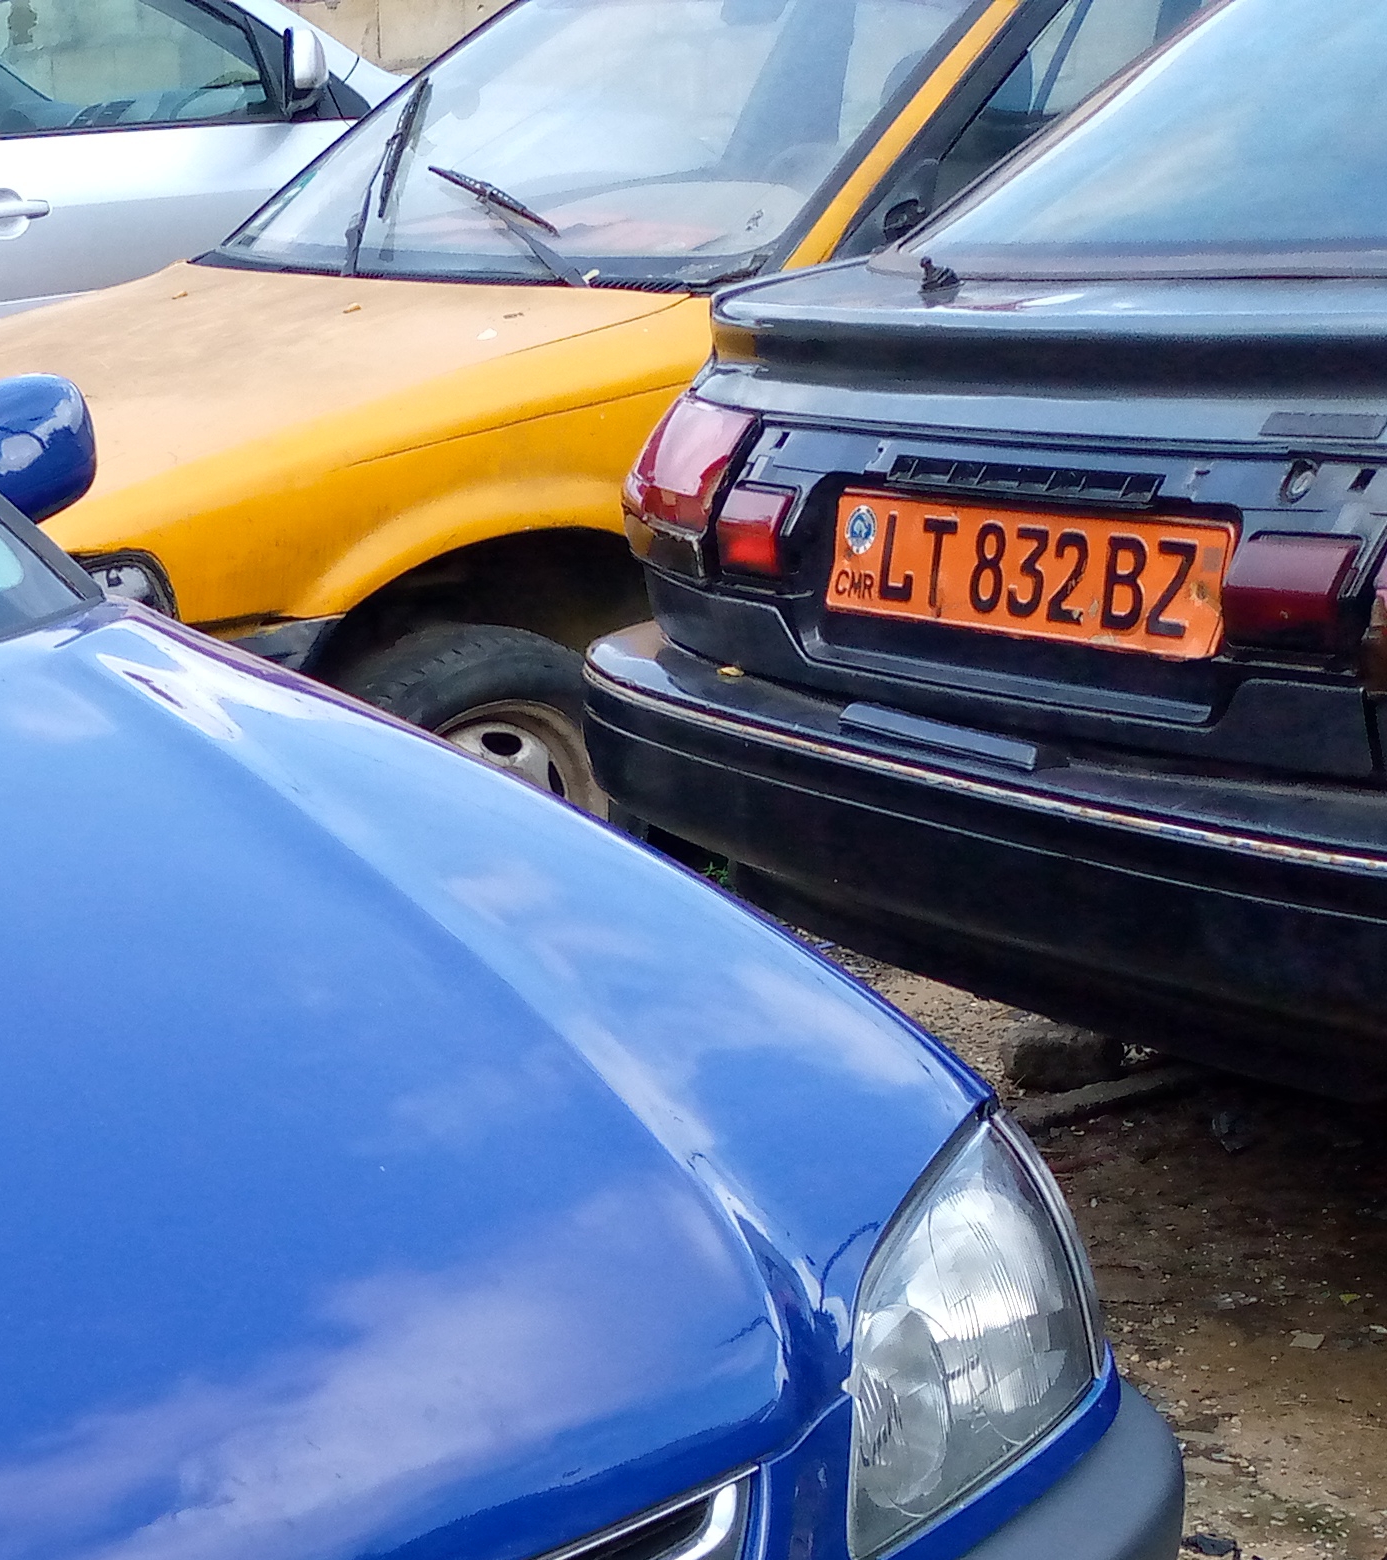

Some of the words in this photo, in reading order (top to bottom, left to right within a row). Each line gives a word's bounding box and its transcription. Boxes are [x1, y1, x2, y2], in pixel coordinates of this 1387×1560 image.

[835, 569, 874, 600] CMR
[878, 513, 959, 612] LT
[969, 522, 1089, 626] 832
[1100, 535, 1198, 638] BZ
